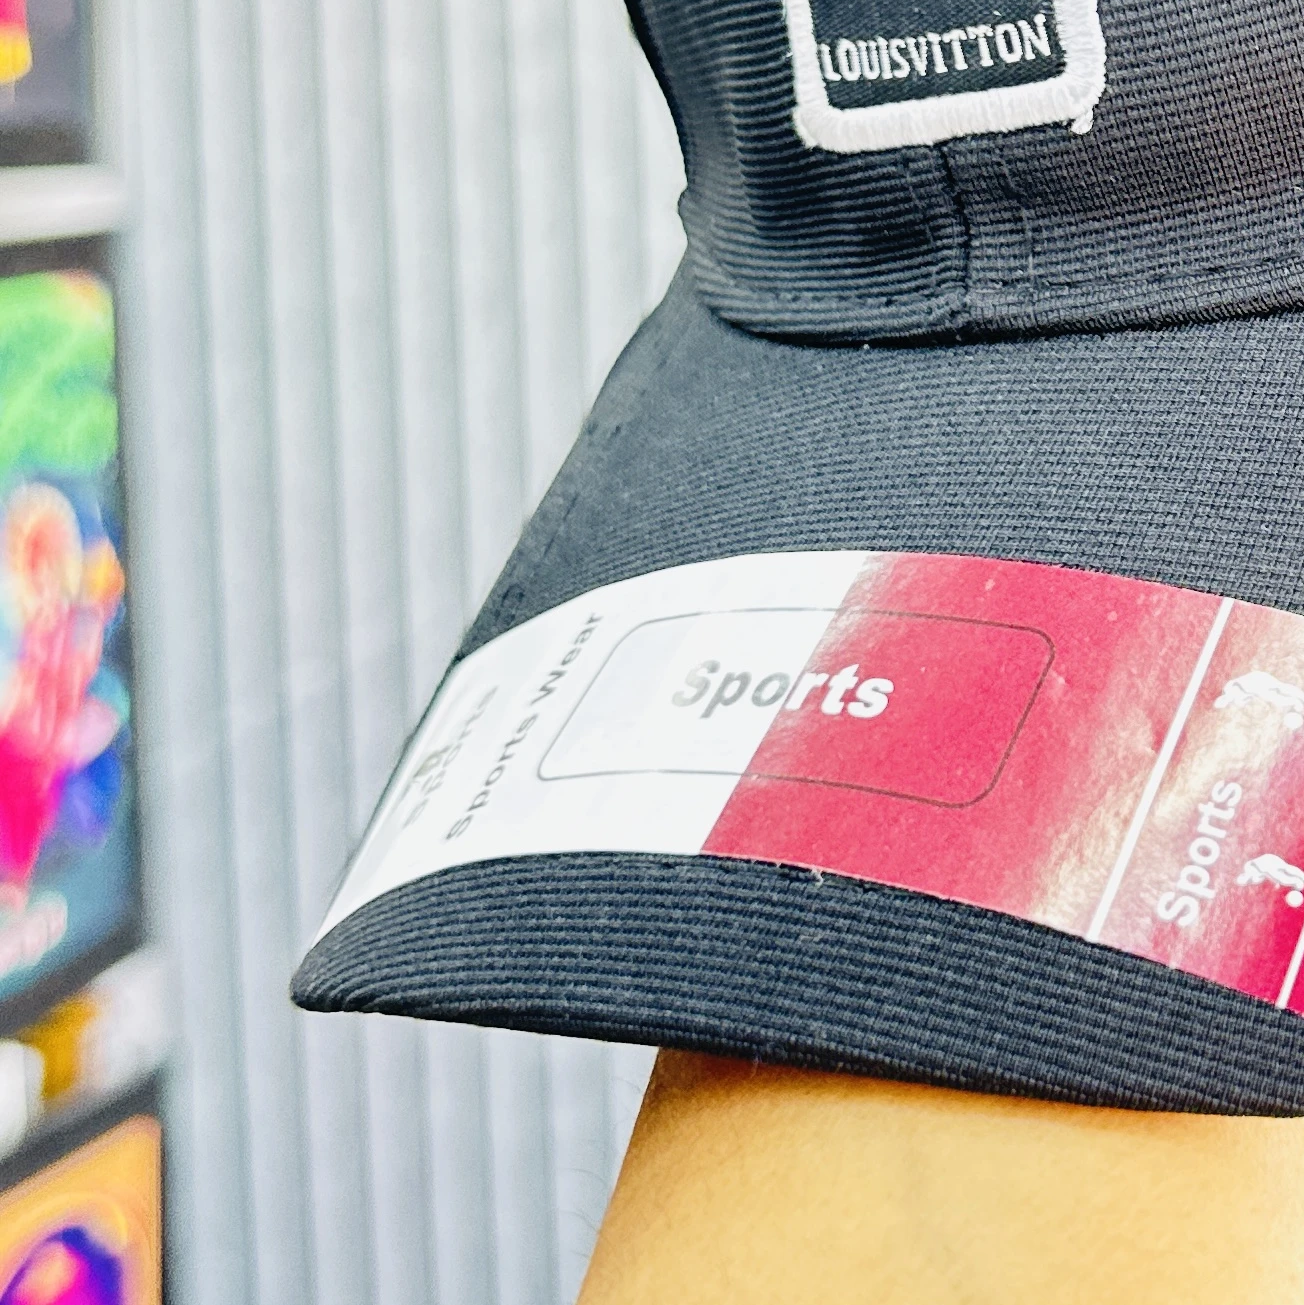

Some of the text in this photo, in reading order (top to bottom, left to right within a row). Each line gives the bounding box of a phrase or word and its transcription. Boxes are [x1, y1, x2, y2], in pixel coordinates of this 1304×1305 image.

[818, 14, 1052, 82] LOUISVITTON
[445, 611, 603, 841] Sports Wear
[671, 658, 895, 720] Sports
[1156, 779, 1243, 927] Sports
